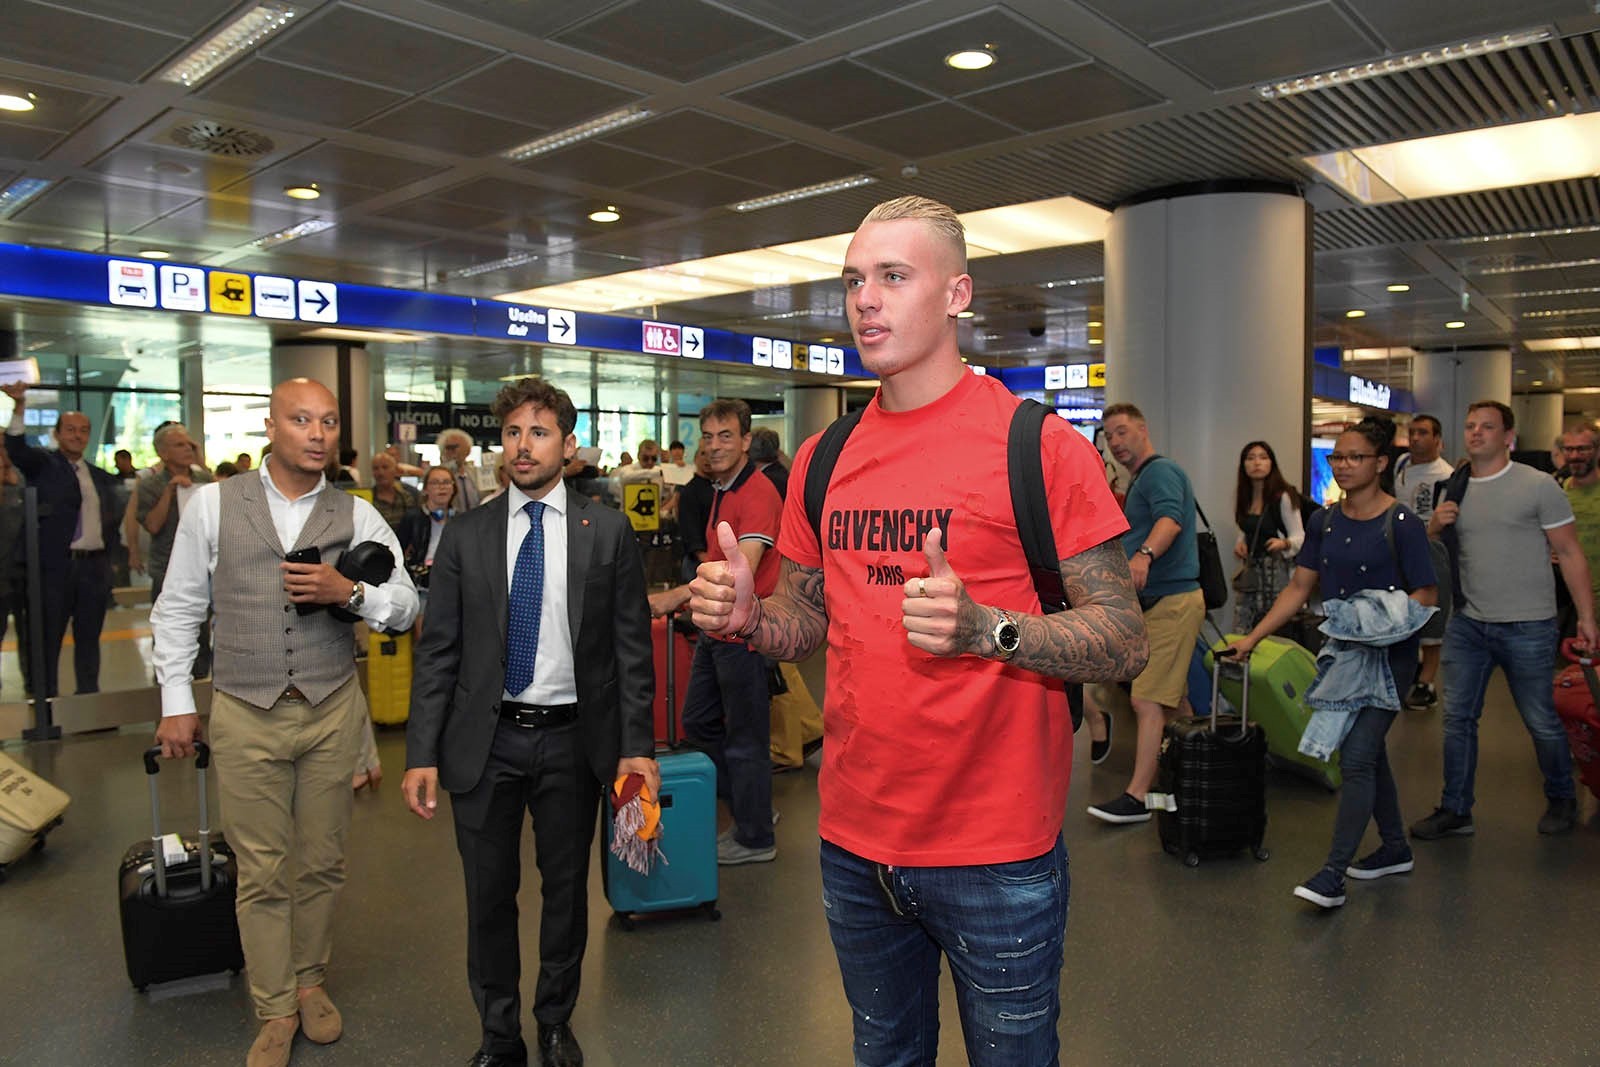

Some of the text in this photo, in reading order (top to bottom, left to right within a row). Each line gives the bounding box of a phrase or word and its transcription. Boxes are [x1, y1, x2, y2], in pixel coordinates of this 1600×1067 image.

[173, 272, 189, 293] P
[395, 411, 442, 425] USCITA
[460, 414, 500, 428] NO EX
[681, 421, 694, 446] 2
[828, 508, 953, 552] GIVENCHY
[867, 564, 905, 586] PARIS
